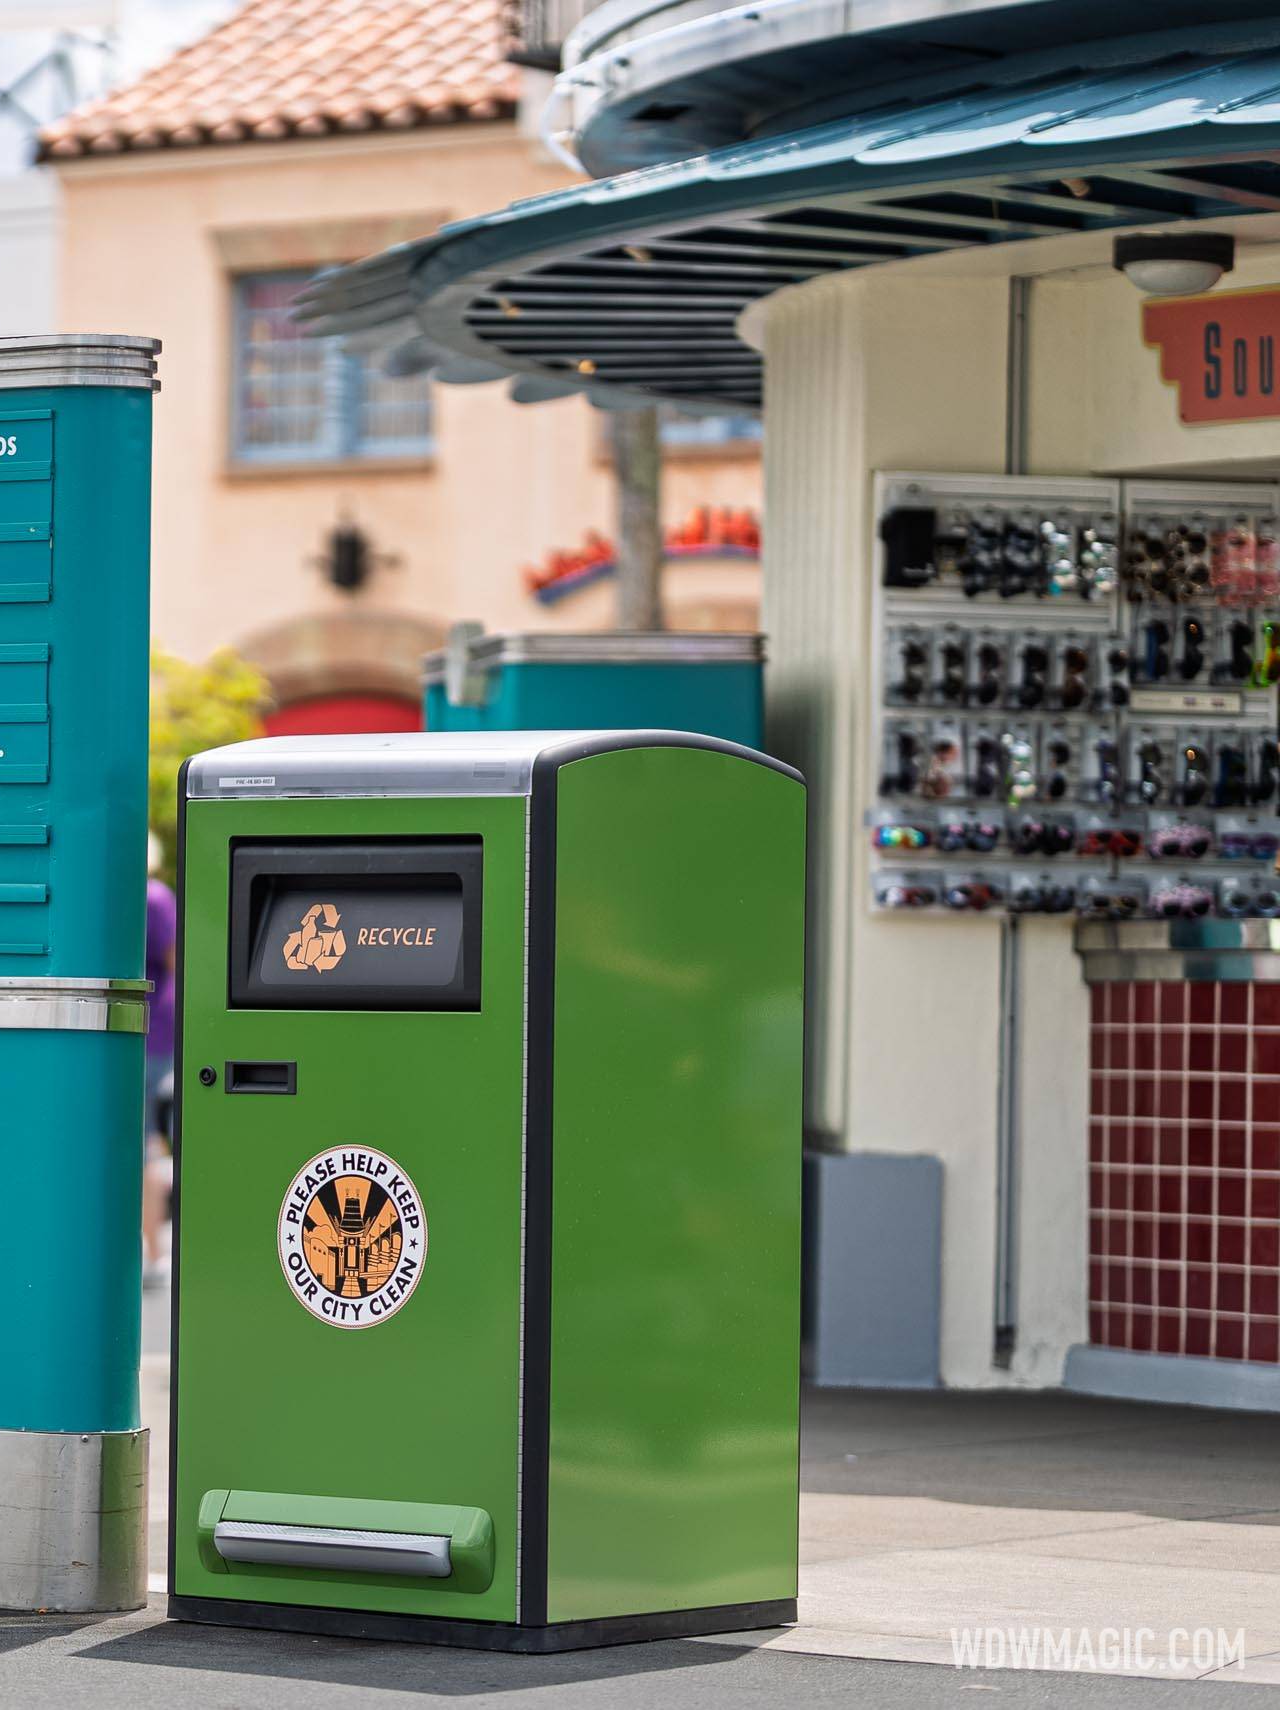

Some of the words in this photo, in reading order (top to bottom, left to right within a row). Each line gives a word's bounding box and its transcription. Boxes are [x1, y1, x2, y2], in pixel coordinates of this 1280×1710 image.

[357, 927, 437, 946] RECYCLE
[286, 1157, 337, 1225] PLEASE
[342, 1153, 388, 1178] HELP
[387, 1174, 420, 1230] KEEP
[287, 1252, 319, 1302] OUR
[321, 1296, 363, 1321] CITY
[369, 1256, 418, 1315] CLEAN
